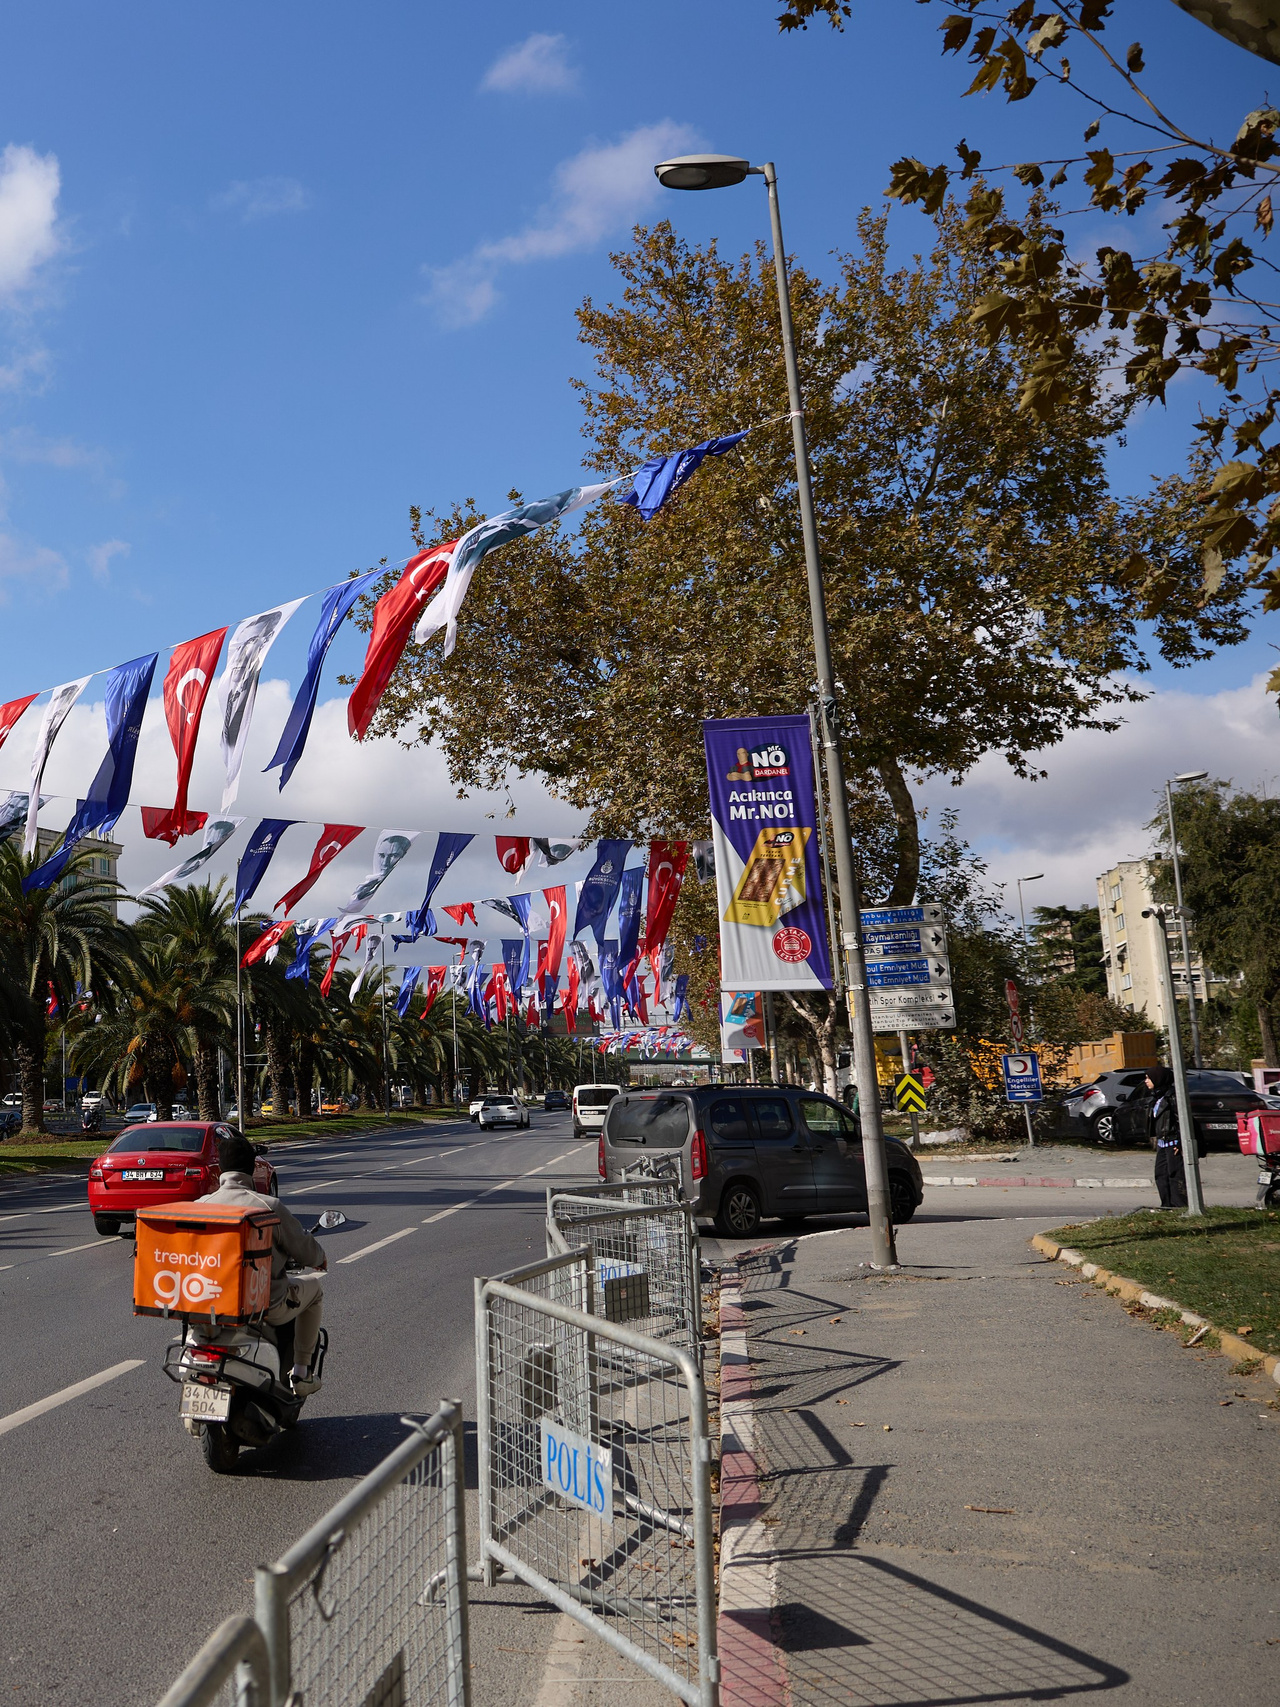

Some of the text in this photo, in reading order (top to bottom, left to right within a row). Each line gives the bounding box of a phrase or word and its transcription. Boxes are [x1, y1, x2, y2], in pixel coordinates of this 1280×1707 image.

[752, 750, 786, 767] NO
[729, 790, 792, 802] Acıkınca
[730, 803, 794, 820] Mr.NO!
[775, 858, 801, 905] GURME
[777, 930, 806, 940] TAPTAZE
[866, 931, 917, 943] Kaymakamlığı
[880, 963, 909, 971] Emniyet
[910, 961, 928, 969] Müd.
[883, 976, 911, 984] Emniyet
[880, 997, 896, 1006] Spor
[899, 995, 935, 1004] Kompleksi
[154, 1248, 220, 1269] trendyol
[153, 1270, 222, 1310] go
[185, 1386, 227, 1400] 34 KVE
[192, 1401, 215, 1414] 504
[546, 1433, 604, 1512] POLİS
